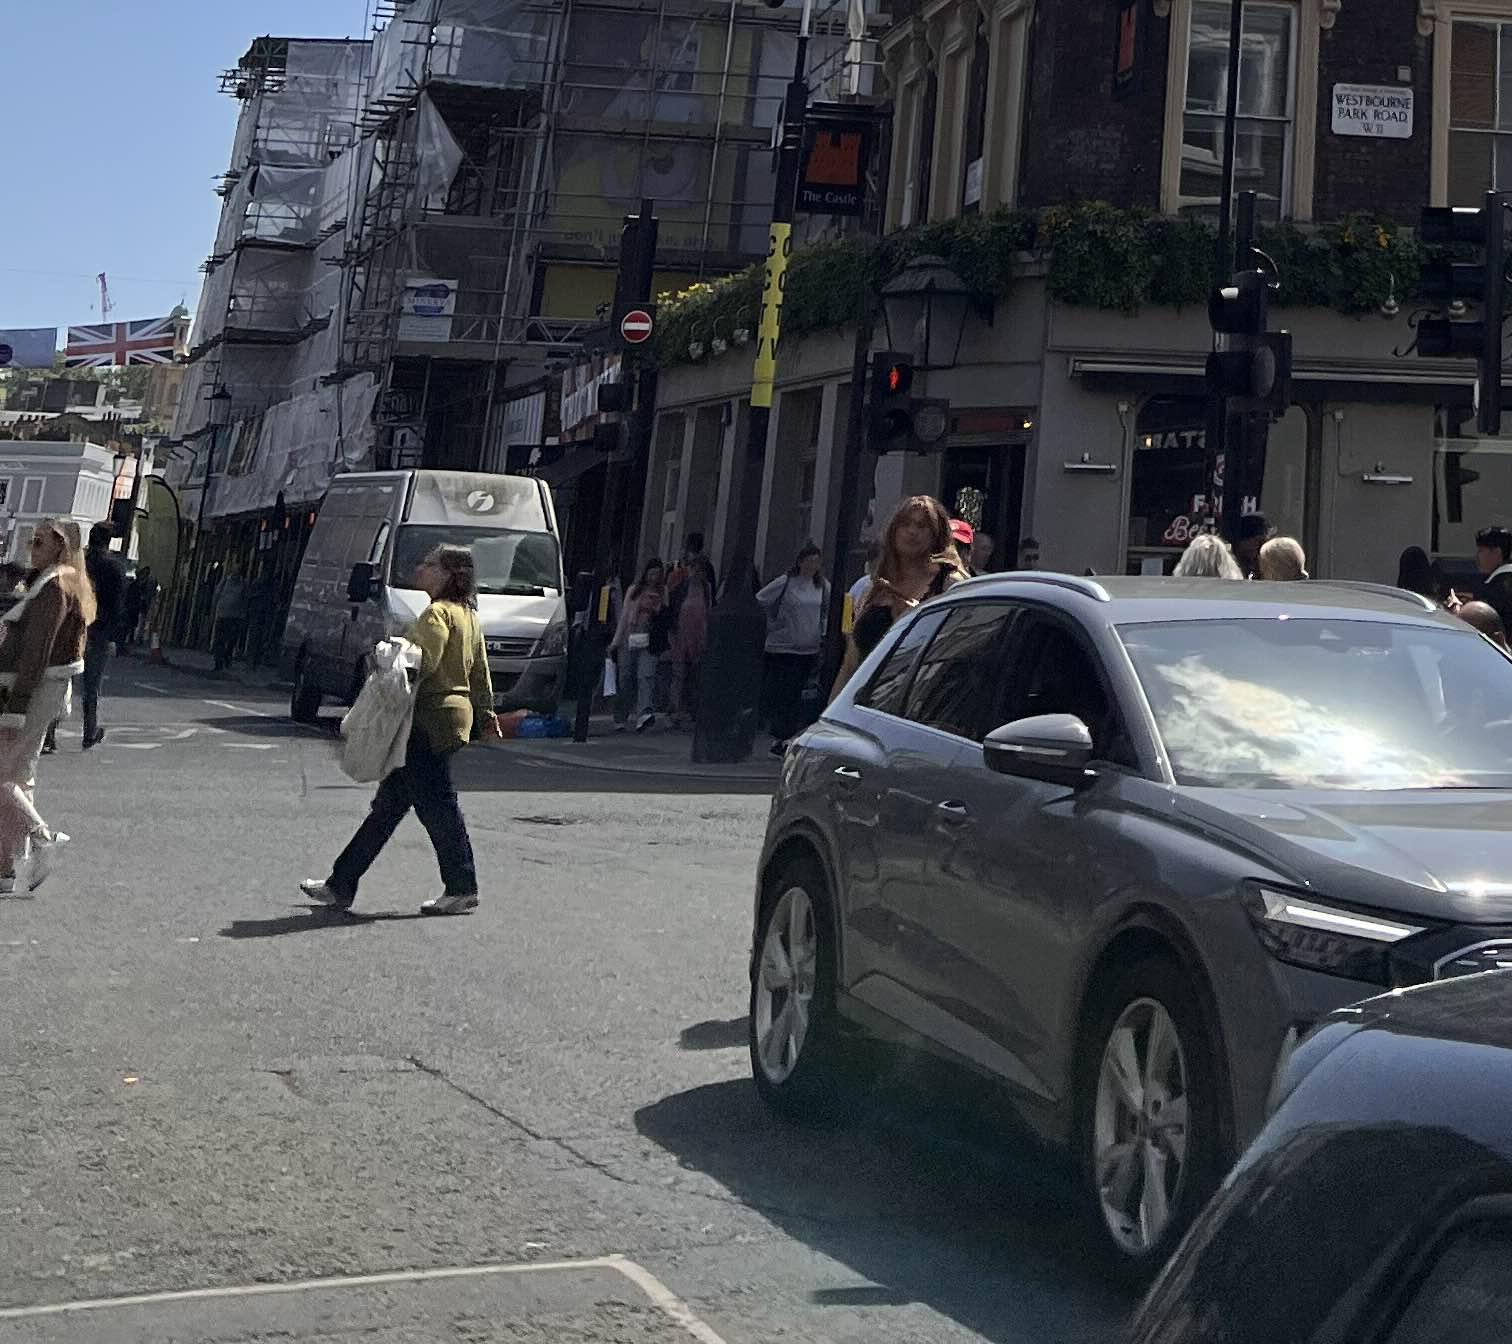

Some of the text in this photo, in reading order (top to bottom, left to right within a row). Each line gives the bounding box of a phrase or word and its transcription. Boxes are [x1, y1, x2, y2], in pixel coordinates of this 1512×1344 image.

[1336, 94, 1412, 110] WESTBOURNE
[1337, 107, 1408, 123] PARK ROAD
[802, 189, 859, 207] The Castle
